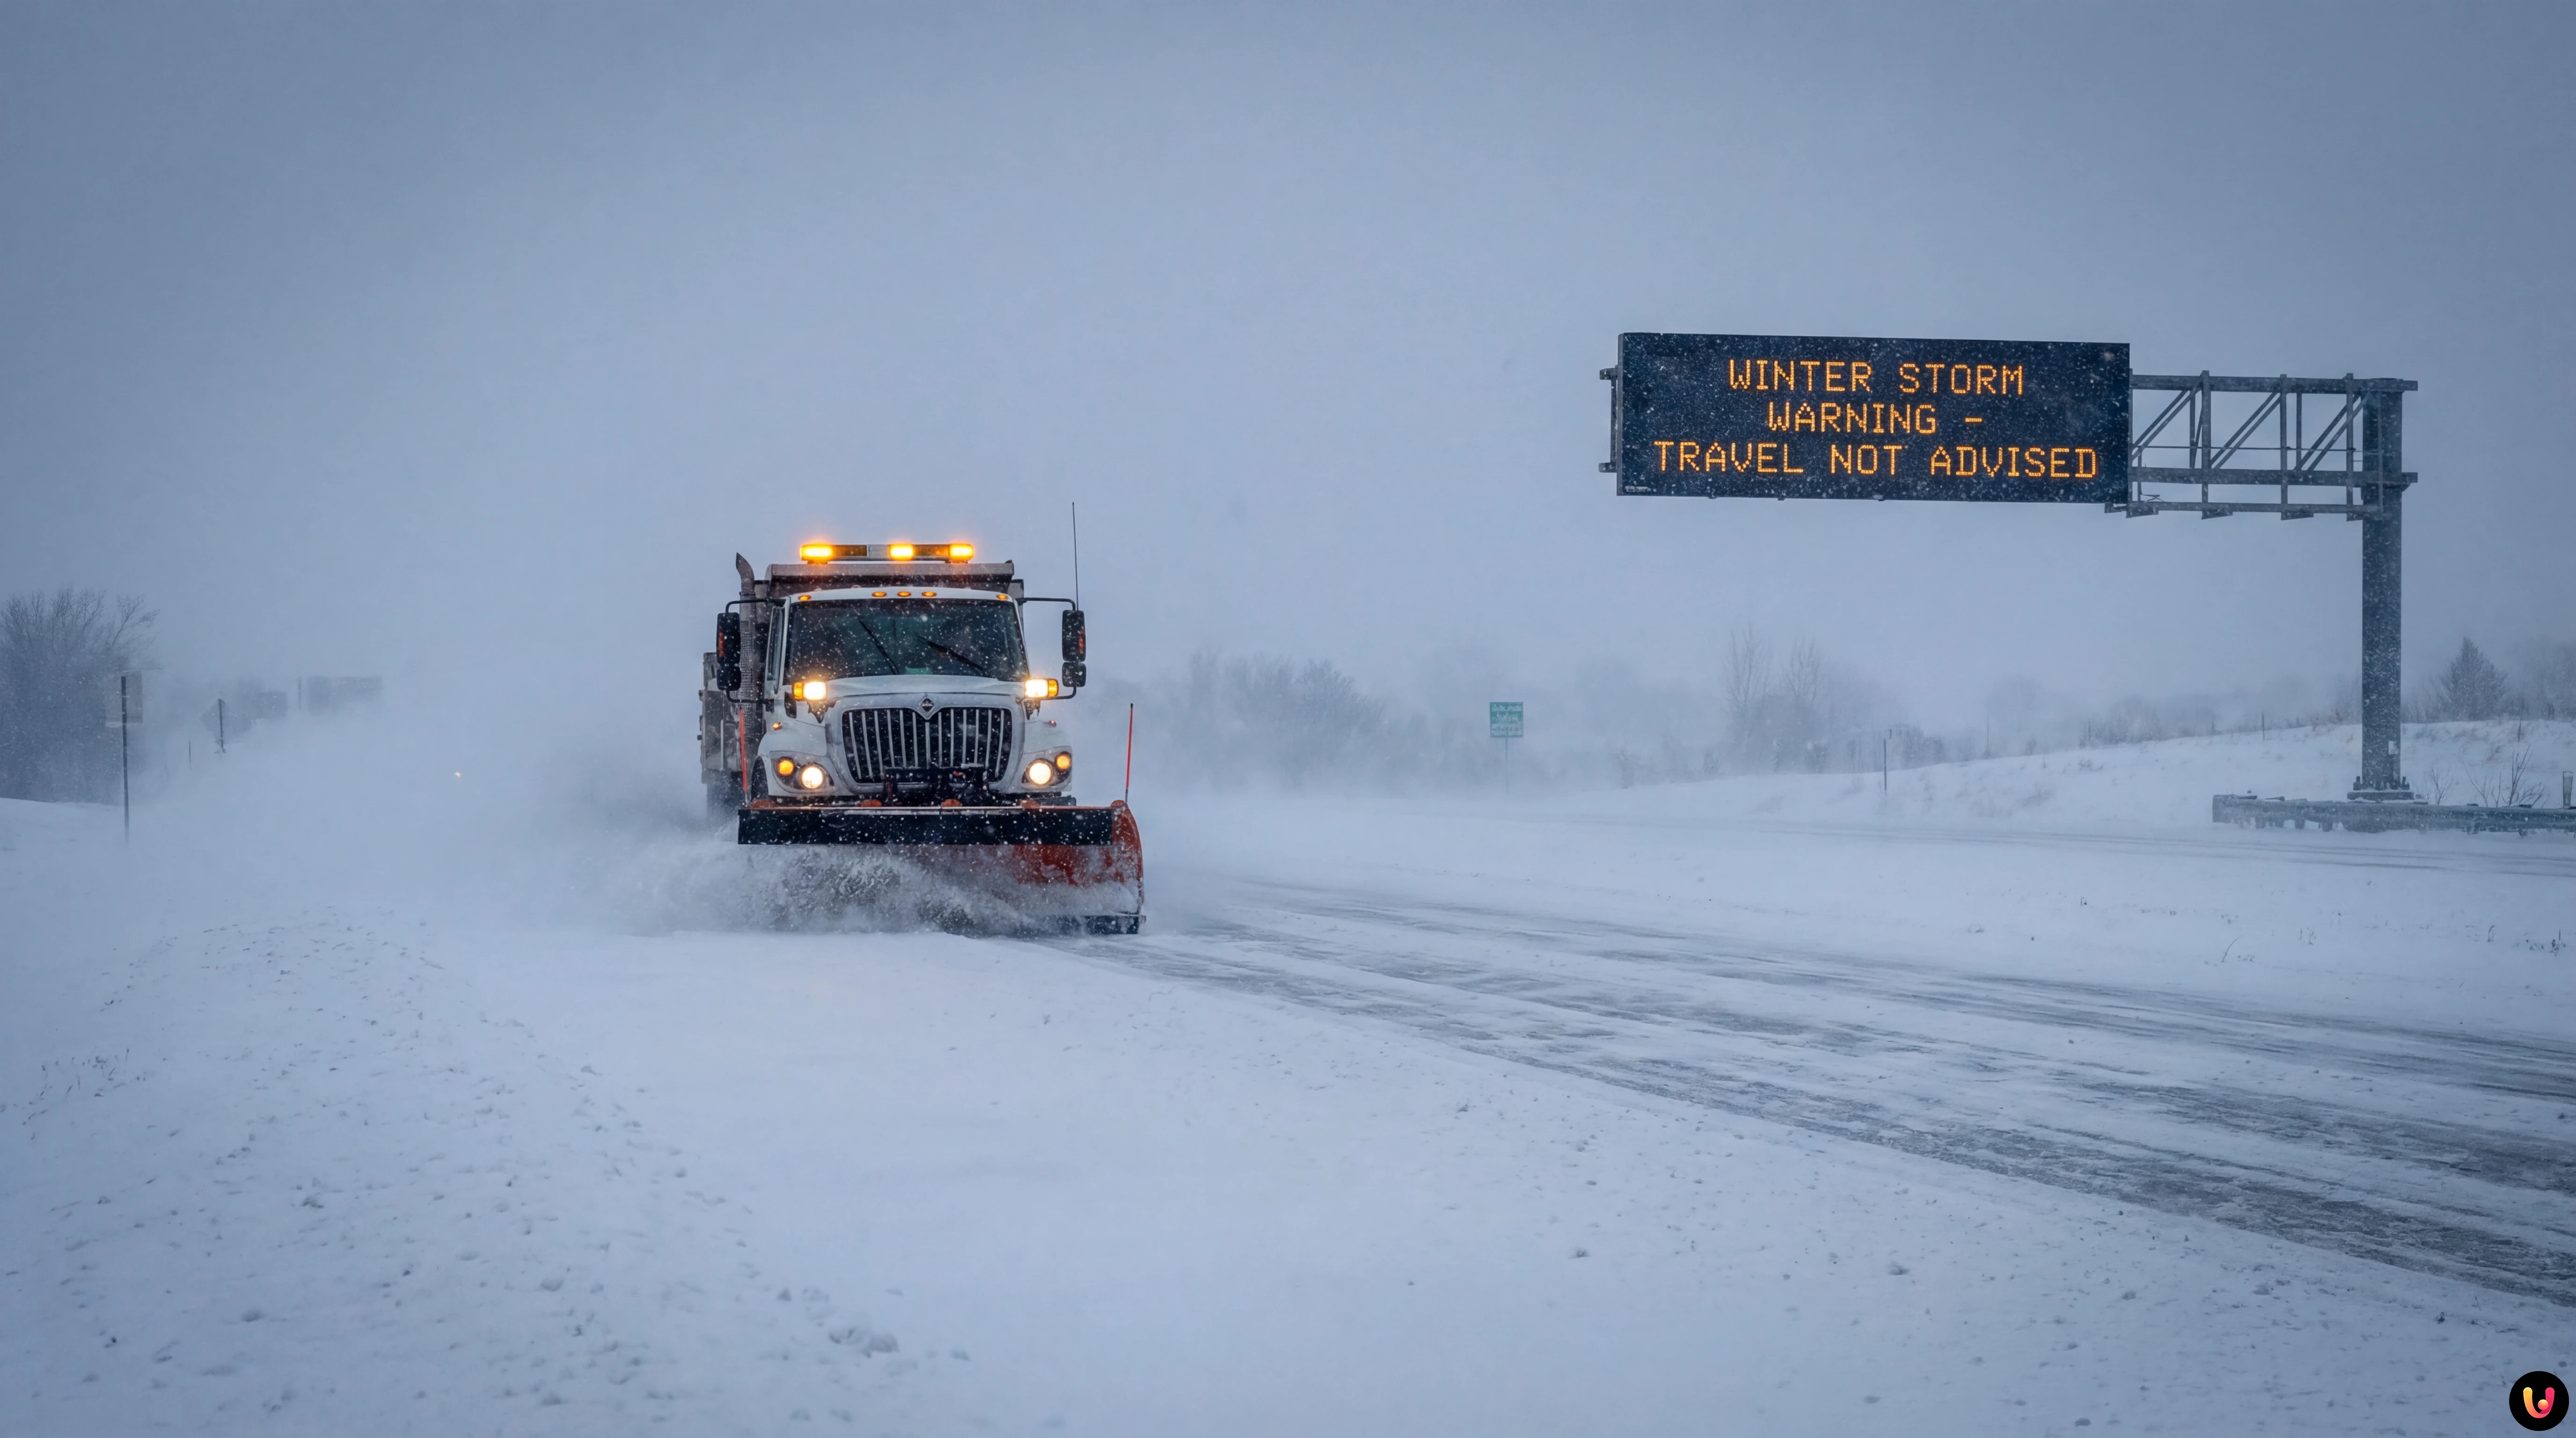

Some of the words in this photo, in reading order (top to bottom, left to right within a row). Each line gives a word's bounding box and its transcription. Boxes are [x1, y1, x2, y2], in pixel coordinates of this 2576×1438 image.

[1729, 359, 1873, 392] WINTER
[1899, 362, 2023, 395] STORM
[1768, 402, 1936, 434] WARNING
[1653, 440, 1804, 473] TRAVEL
[1830, 444, 1903, 475] NOT
[1930, 445, 2097, 478] ADVISED
